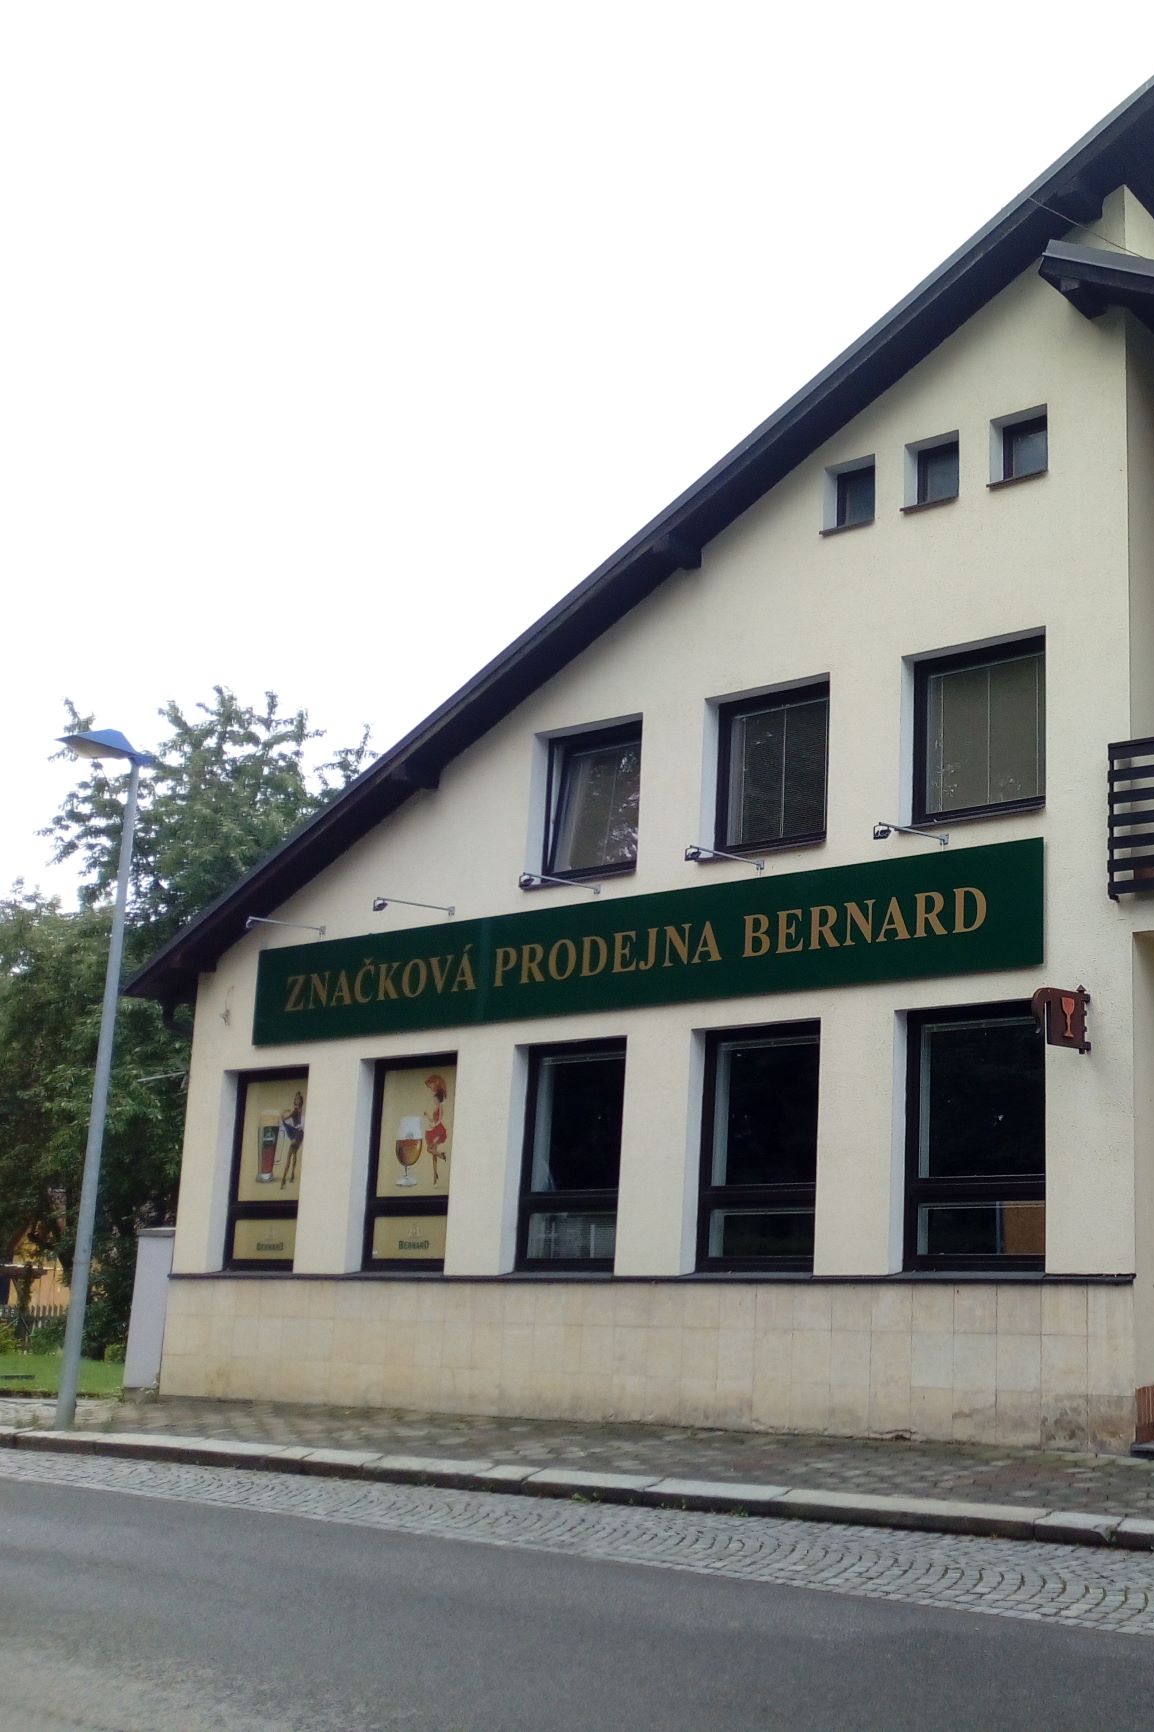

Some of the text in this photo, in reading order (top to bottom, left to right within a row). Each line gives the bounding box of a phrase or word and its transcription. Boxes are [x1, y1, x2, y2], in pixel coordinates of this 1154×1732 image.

[283, 886, 987, 1012] ZNAČKOVÁ PRODEJNA BERNARD
